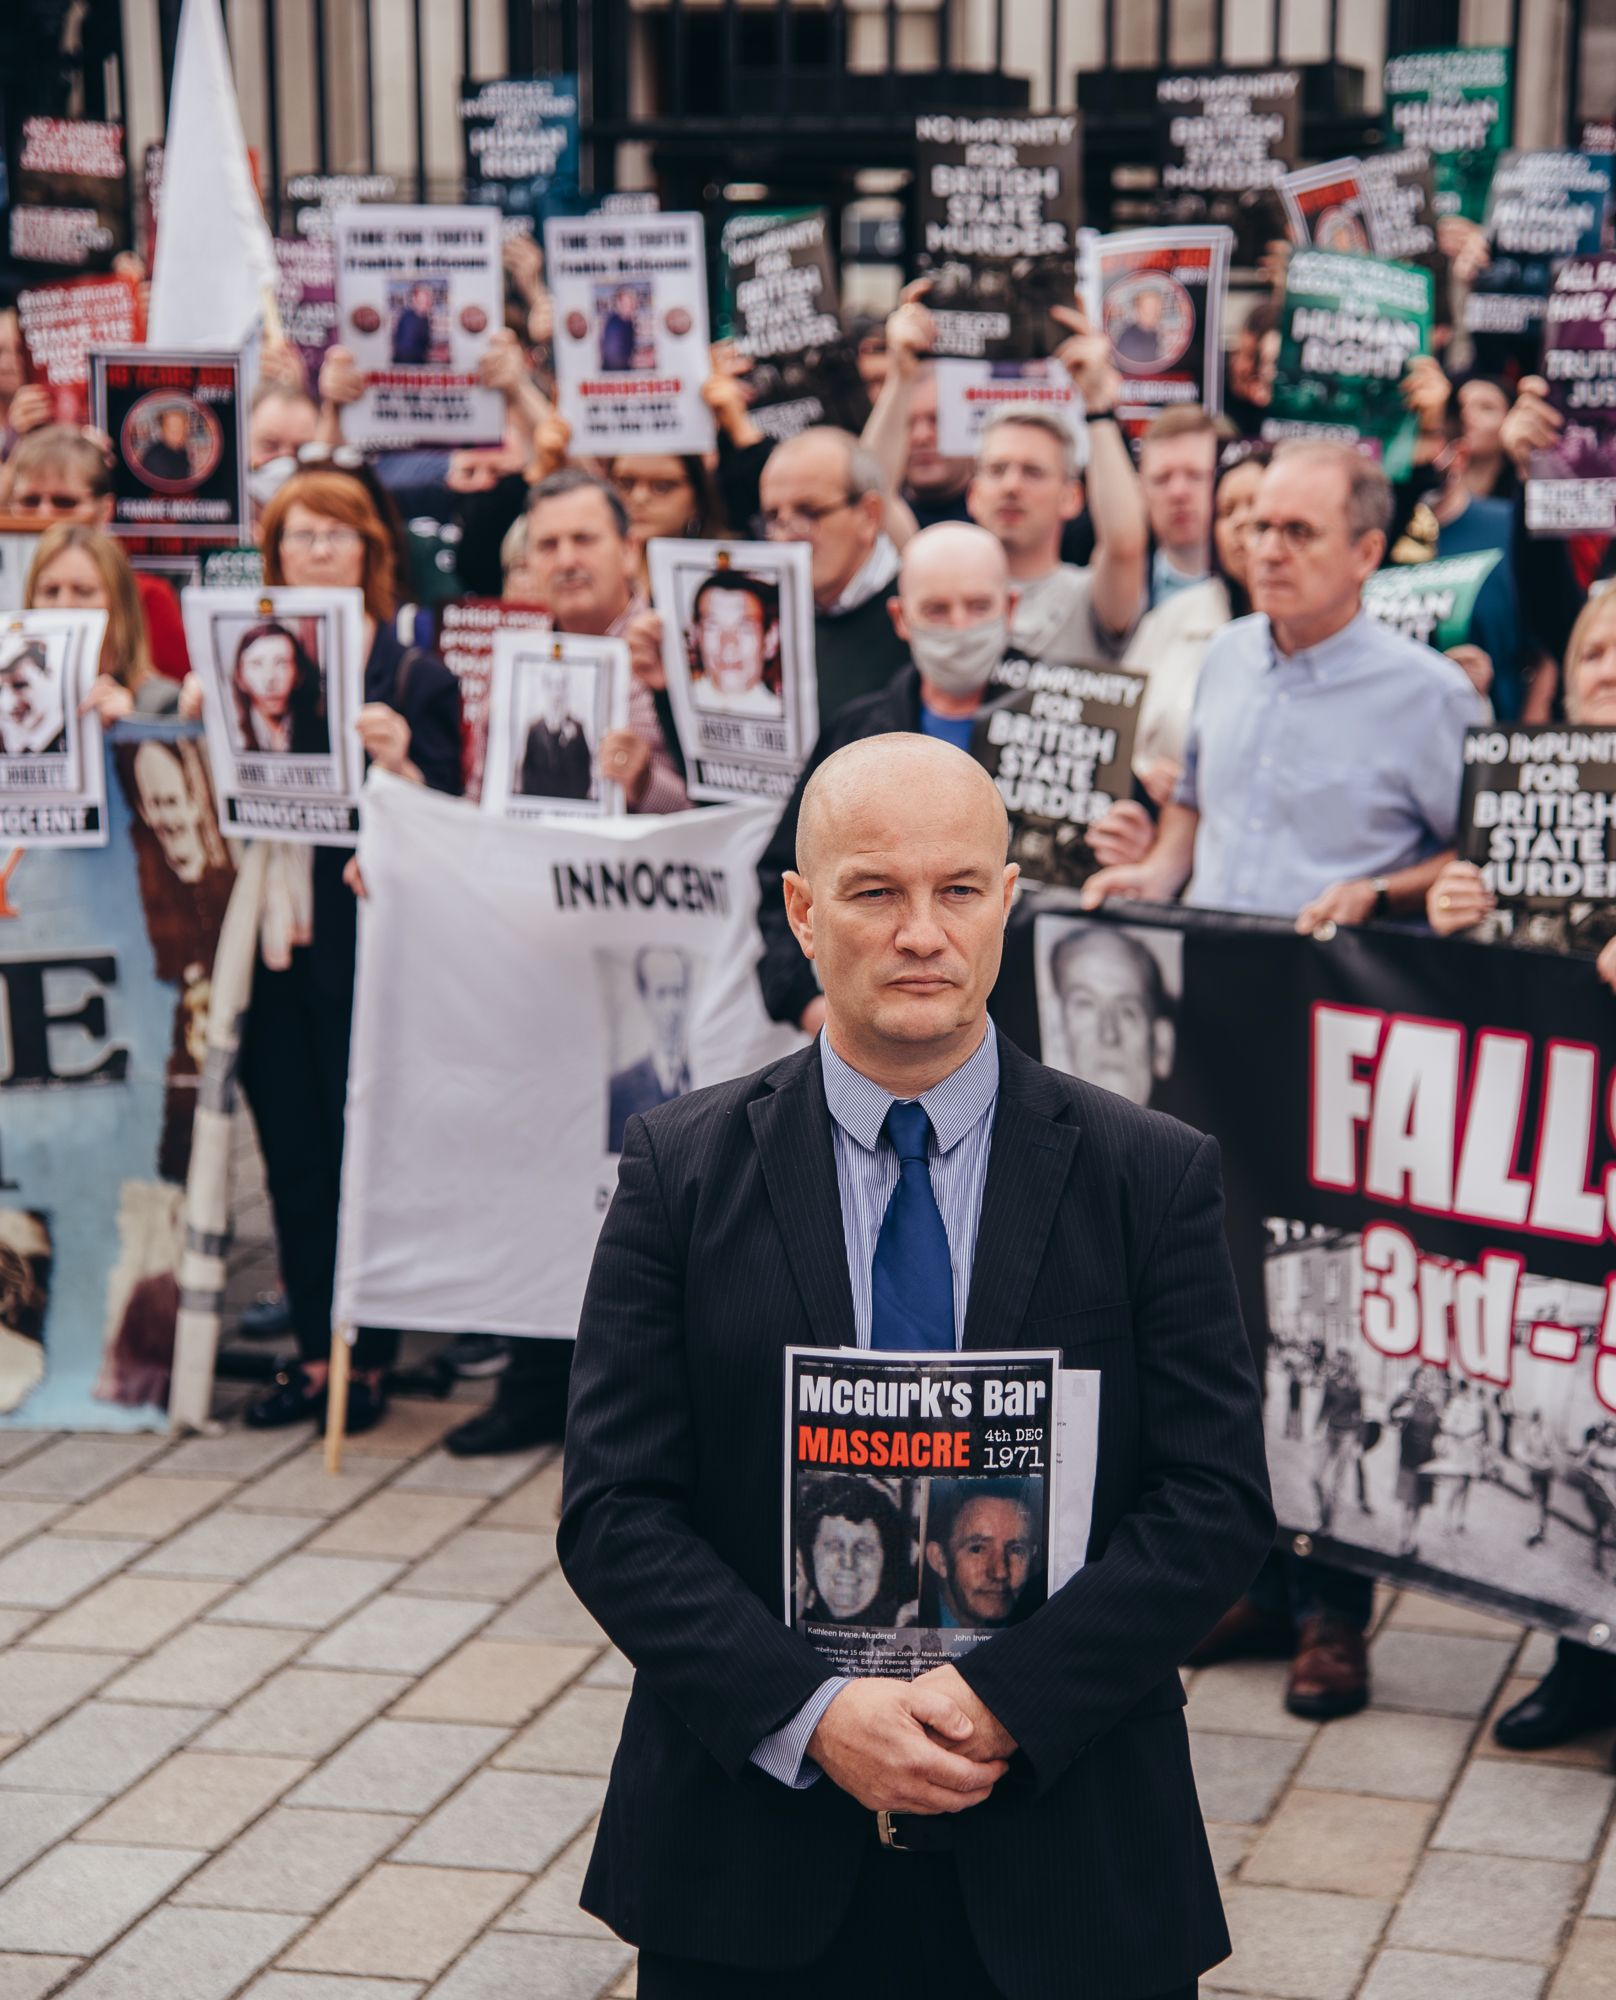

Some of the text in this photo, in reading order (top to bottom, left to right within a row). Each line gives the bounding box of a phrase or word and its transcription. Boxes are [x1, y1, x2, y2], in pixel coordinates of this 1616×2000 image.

[991, 659, 1145, 708] NO IMPUNITY
[1031, 691, 1083, 723] FOR
[987, 709, 1117, 765] BRITISH
[1464, 732, 1509, 765] NO
[998, 743, 1097, 793] STATE
[1518, 763, 1580, 793] FOR
[235, 800, 350, 833] INNOCENT
[995, 776, 1114, 824] URDER
[1473, 791, 1616, 829] BRITISH
[0, 805, 86, 834] OCENT
[1488, 826, 1606, 863] STATE
[552, 862, 731, 914] INNOCENT
[1309, 1000, 1616, 1245] FALL
[799, 1374, 1046, 1418] McGurk's Bar
[798, 1425, 970, 1468] MASSACRE
[984, 1428, 1044, 1443] 4th DEC
[983, 1446, 1045, 1469] 1971
[807, 1626, 837, 1638] Kathleen
[862, 1631, 897, 1640] Murdered
[953, 1633, 971, 1642] John
